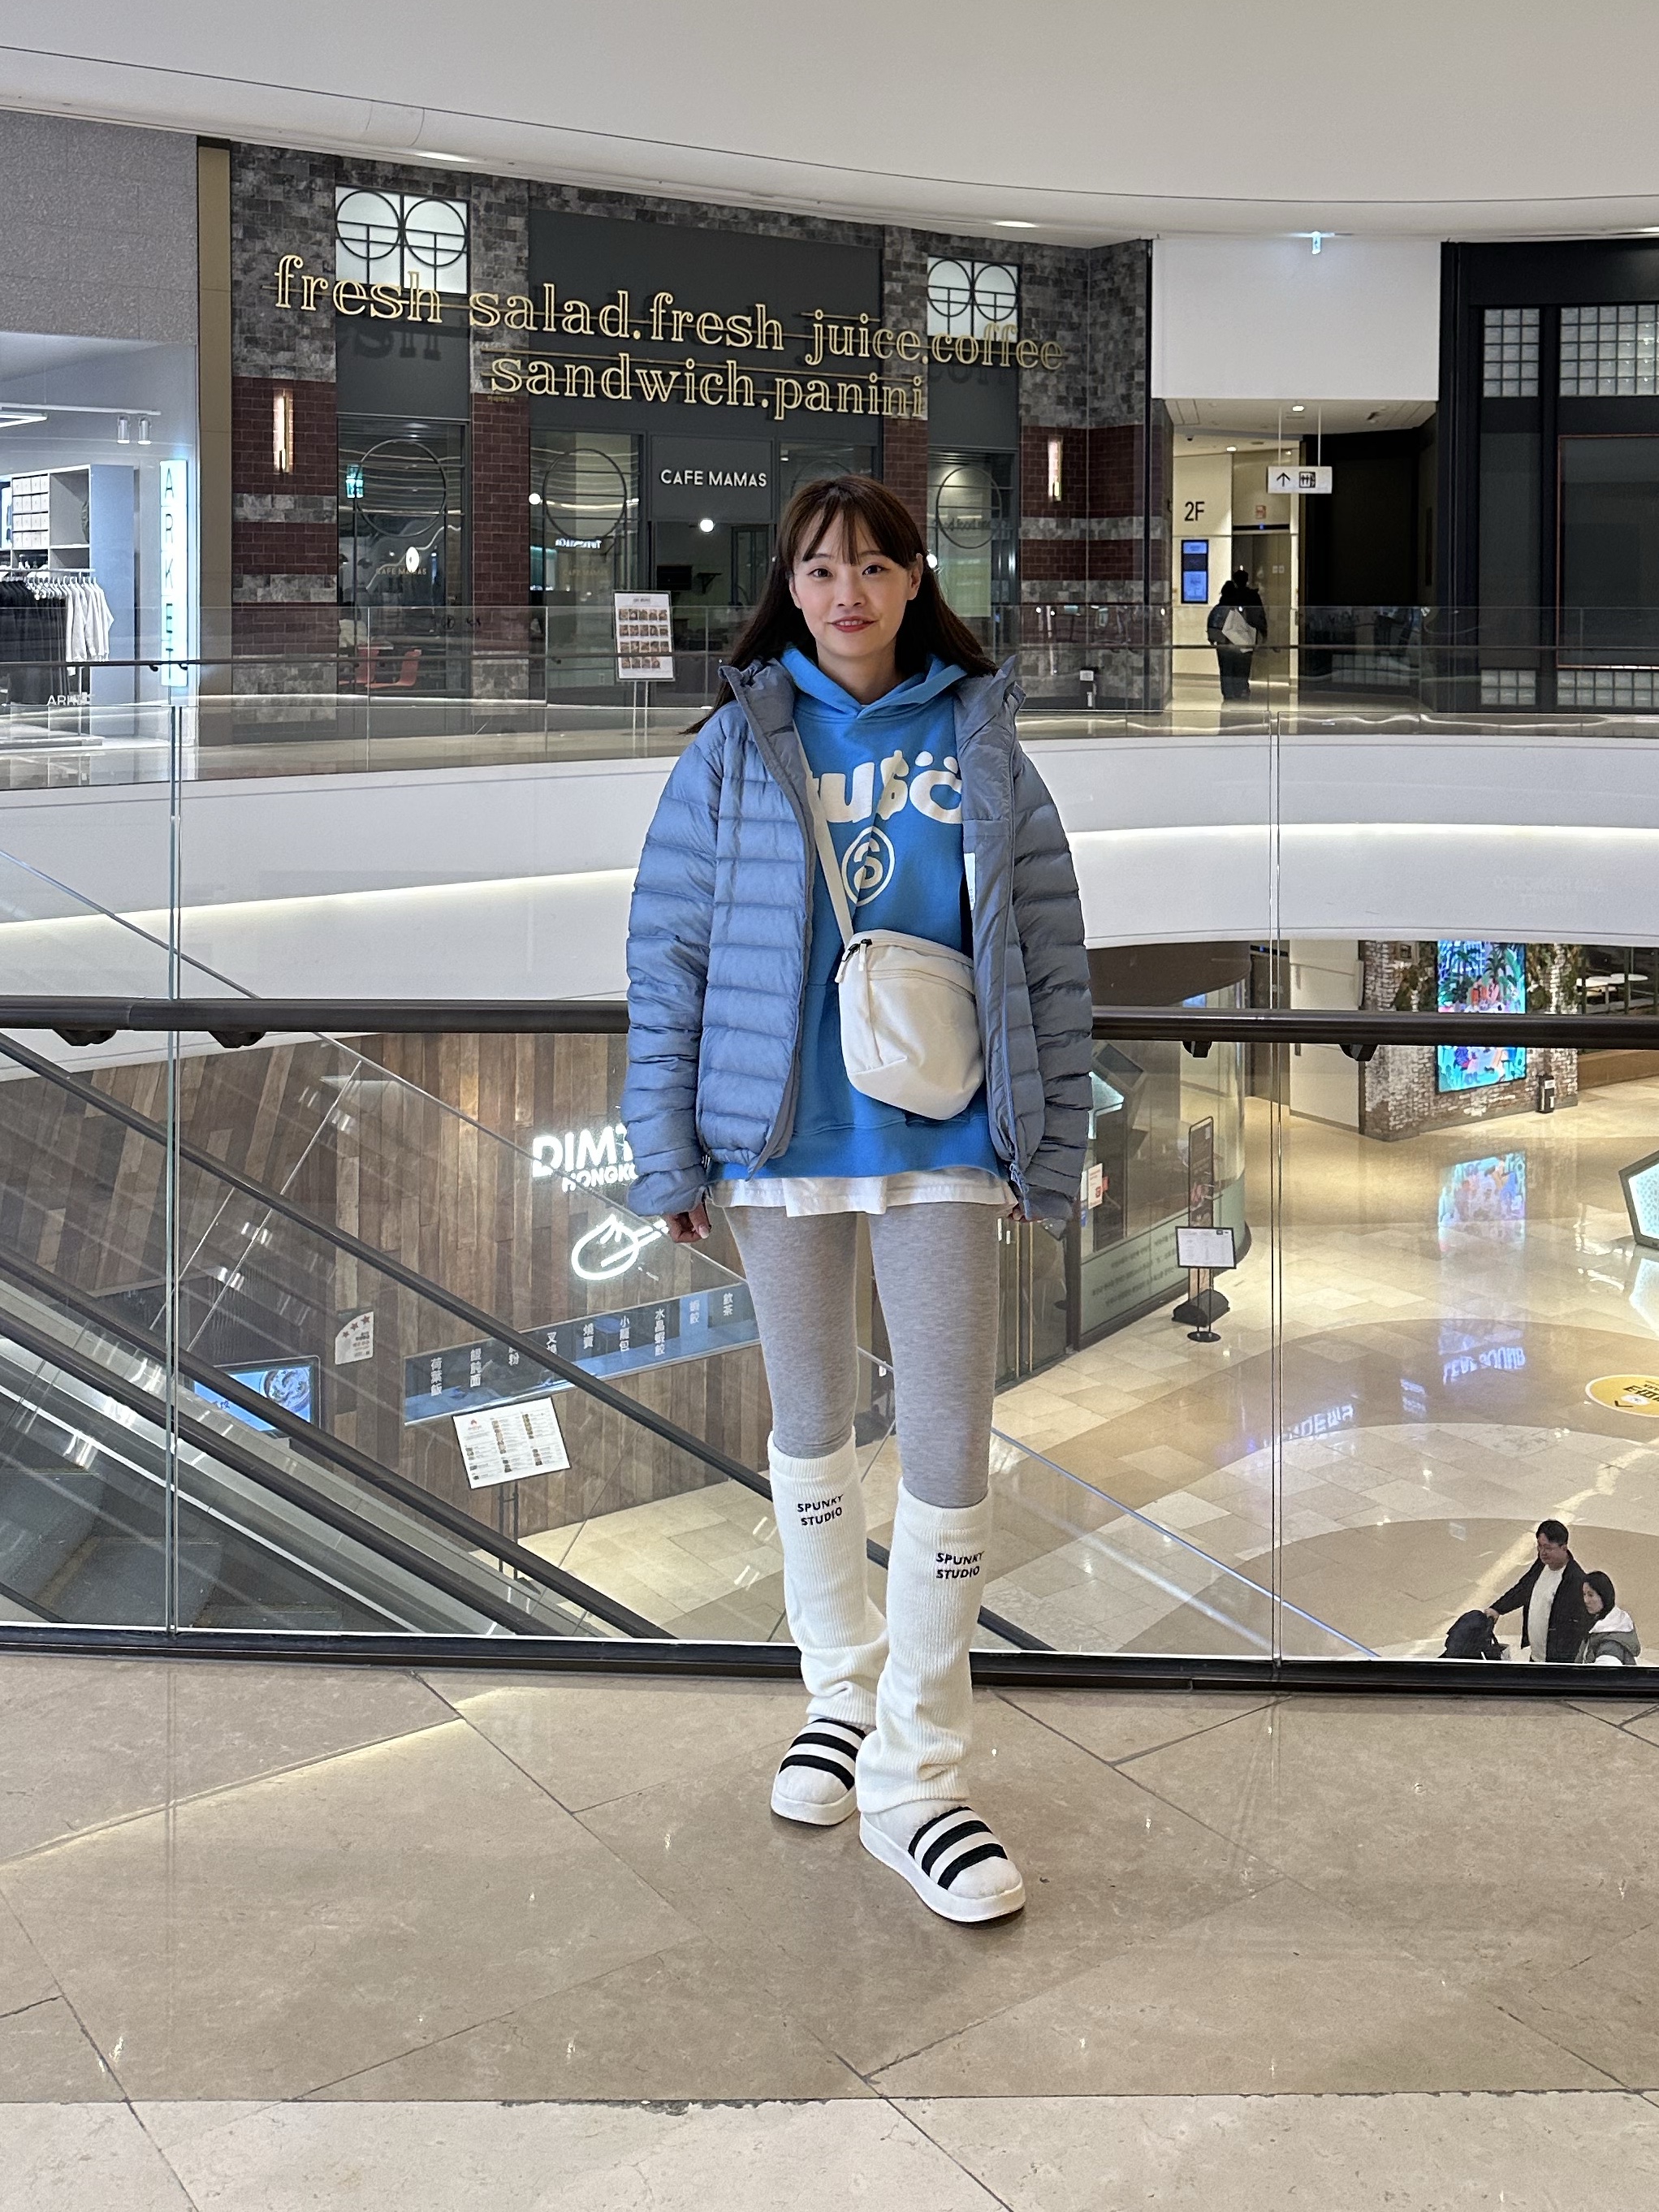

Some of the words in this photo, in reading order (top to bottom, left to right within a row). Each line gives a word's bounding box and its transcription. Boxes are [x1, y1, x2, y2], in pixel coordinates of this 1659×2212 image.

[274, 254, 443, 324] fresh
[660, 469, 704, 486] CAFE
[708, 471, 767, 487] MAMAS
[1184, 501, 1205, 522] 2F
[164, 467, 175, 680] ARKET
[797, 1493, 844, 1513] SPUNKY
[801, 1506, 843, 1526] STUDIO
[935, 1550, 985, 1566] SPUNKY
[935, 1566, 980, 1579] STUDIO
